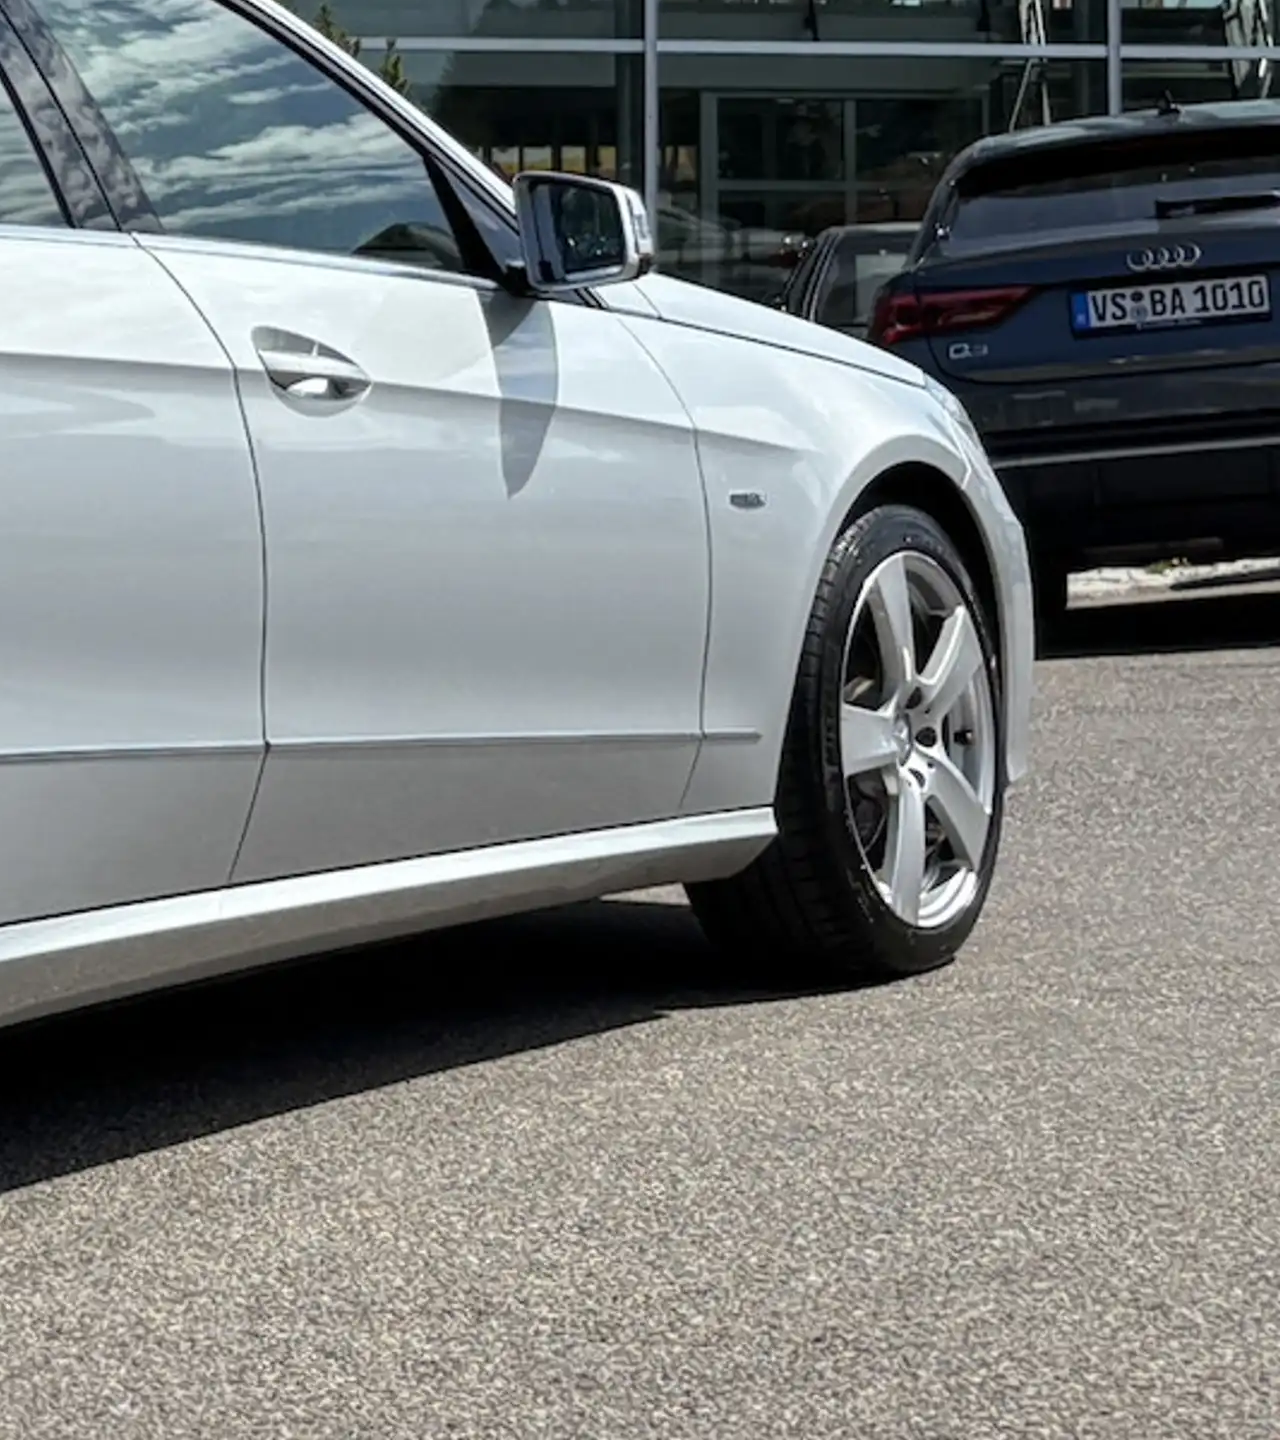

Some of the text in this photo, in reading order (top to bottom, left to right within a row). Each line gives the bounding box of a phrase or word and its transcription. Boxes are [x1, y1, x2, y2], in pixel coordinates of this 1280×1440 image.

[1092, 280, 1265, 322] VS BA 1010
